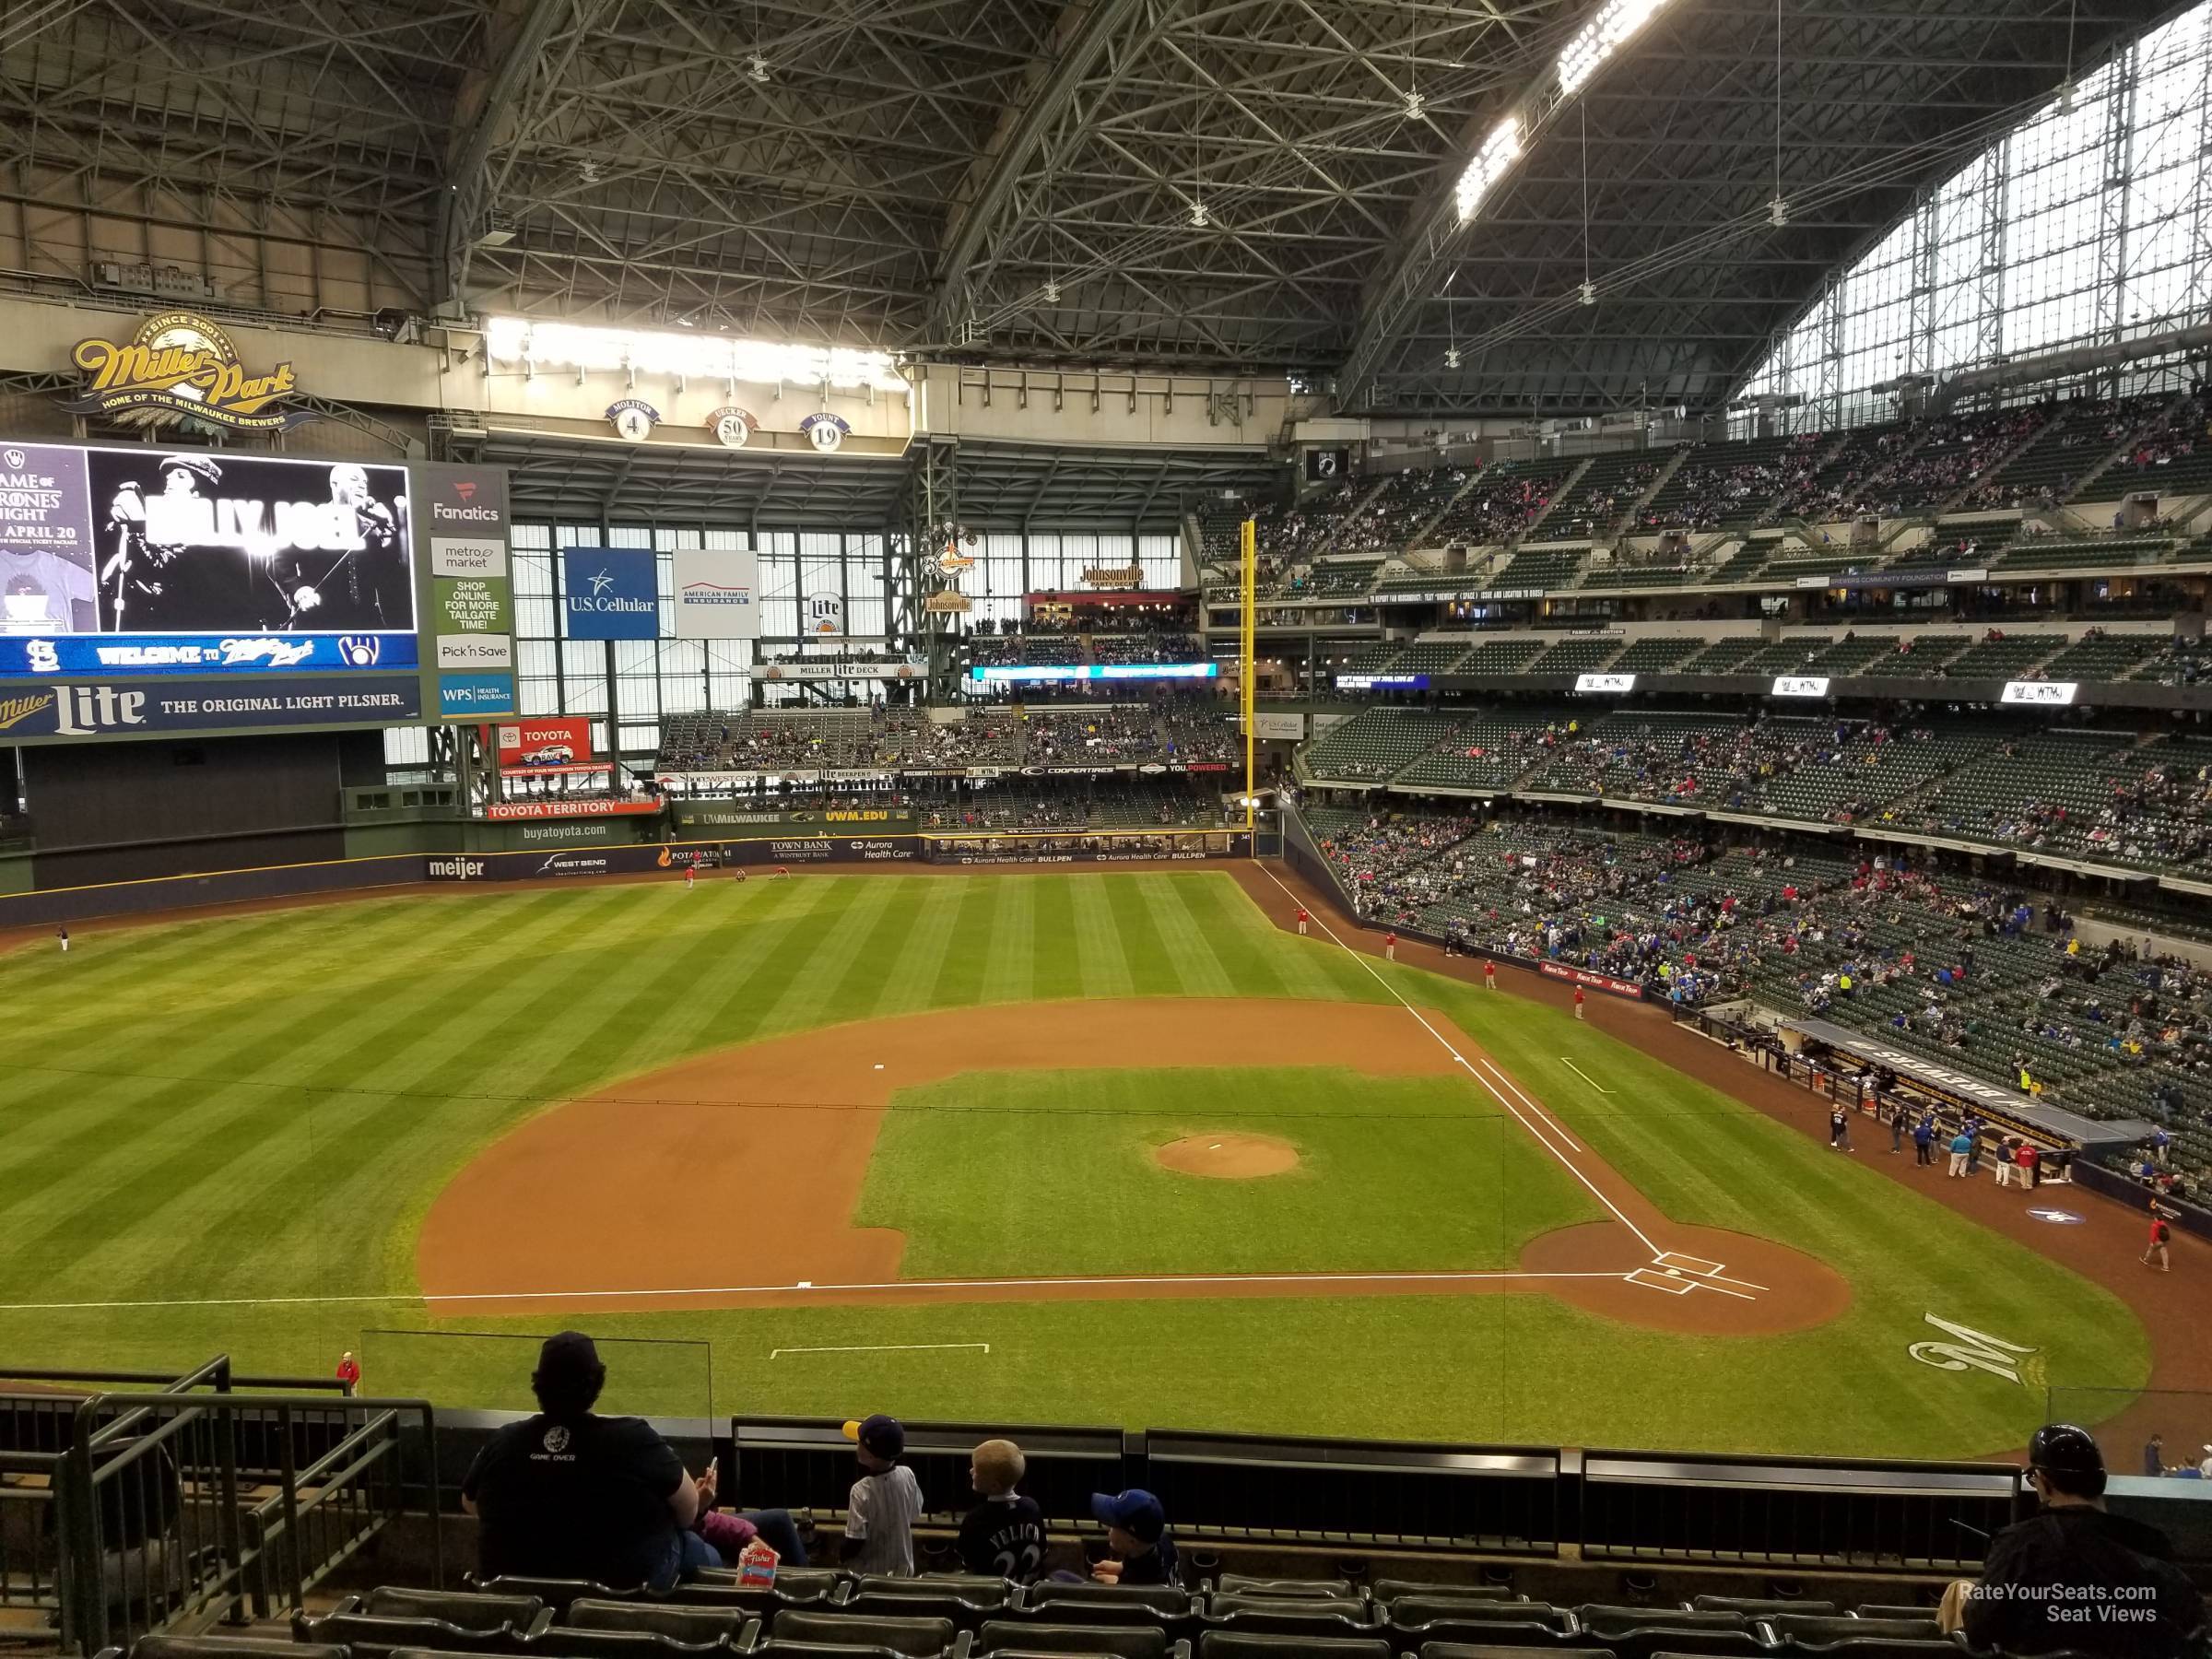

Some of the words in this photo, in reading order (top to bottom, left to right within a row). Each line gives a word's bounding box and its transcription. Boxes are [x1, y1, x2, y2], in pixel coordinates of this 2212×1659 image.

[150, 316, 188, 331] SINCE
[191, 318, 219, 338] 2001
[76, 340, 215, 390] Miller
[190, 359, 295, 405] Park
[102, 394, 132, 409] HOME
[134, 394, 147, 402] OF
[153, 394, 172, 404] THE
[176, 398, 236, 424] MILWAUKEE
[239, 416, 286, 427] BREWERS
[613, 400, 653, 414] MOLITOR
[715, 407, 747, 418] UECKER
[627, 416, 639, 434] 4
[812, 414, 840, 423] YOUNT
[724, 421, 741, 434] 50
[816, 428, 835, 445] 19
[433, 502, 499, 521] Fanatics
[5, 525, 53, 537] APRIL
[57, 527, 76, 538] 20
[446, 547, 481, 557] metro
[446, 558, 487, 568] market
[1080, 564, 1144, 582] Johnsonville
[457, 582, 486, 591] SHOP
[453, 591, 491, 601] ONLINE
[445, 601, 467, 611] FOR
[469, 601, 500, 611] MORE
[570, 596, 594, 612] U.S.
[596, 596, 654, 612] Cellular
[812, 600, 839, 618] Lite
[928, 599, 971, 610] Johnsonville
[449, 610, 496, 620] TAILGATE
[460, 620, 488, 629] TIME!
[97, 646, 201, 665] WELCOME
[204, 649, 218, 660] TO
[442, 646, 466, 656] Pick
[478, 646, 507, 656] Save
[833, 664, 855, 677] Lite
[443, 688, 472, 700] WPS
[0, 693, 54, 721] Miller
[50, 686, 147, 735] Lite
[160, 700, 198, 713] THE
[202, 698, 282, 712] ORIGINAL
[286, 696, 334, 710] LIGHT
[338, 694, 405, 707] PILSNER.
[524, 731, 571, 741] TOYOTA
[491, 806, 543, 818] TOYOTA
[546, 802, 616, 815] TERRITORY
[826, 811, 888, 821] UWM.EDU
[524, 825, 606, 840] buyatoyota.com
[771, 841, 801, 850] TOWN
[804, 841, 832, 850] BANK
[865, 841, 893, 849] Aurora
[865, 850, 891, 858] Health
[893, 850, 912, 858] Care
[429, 857, 484, 879] meijer
[1873, 1051, 2007, 1098] BREWERS
